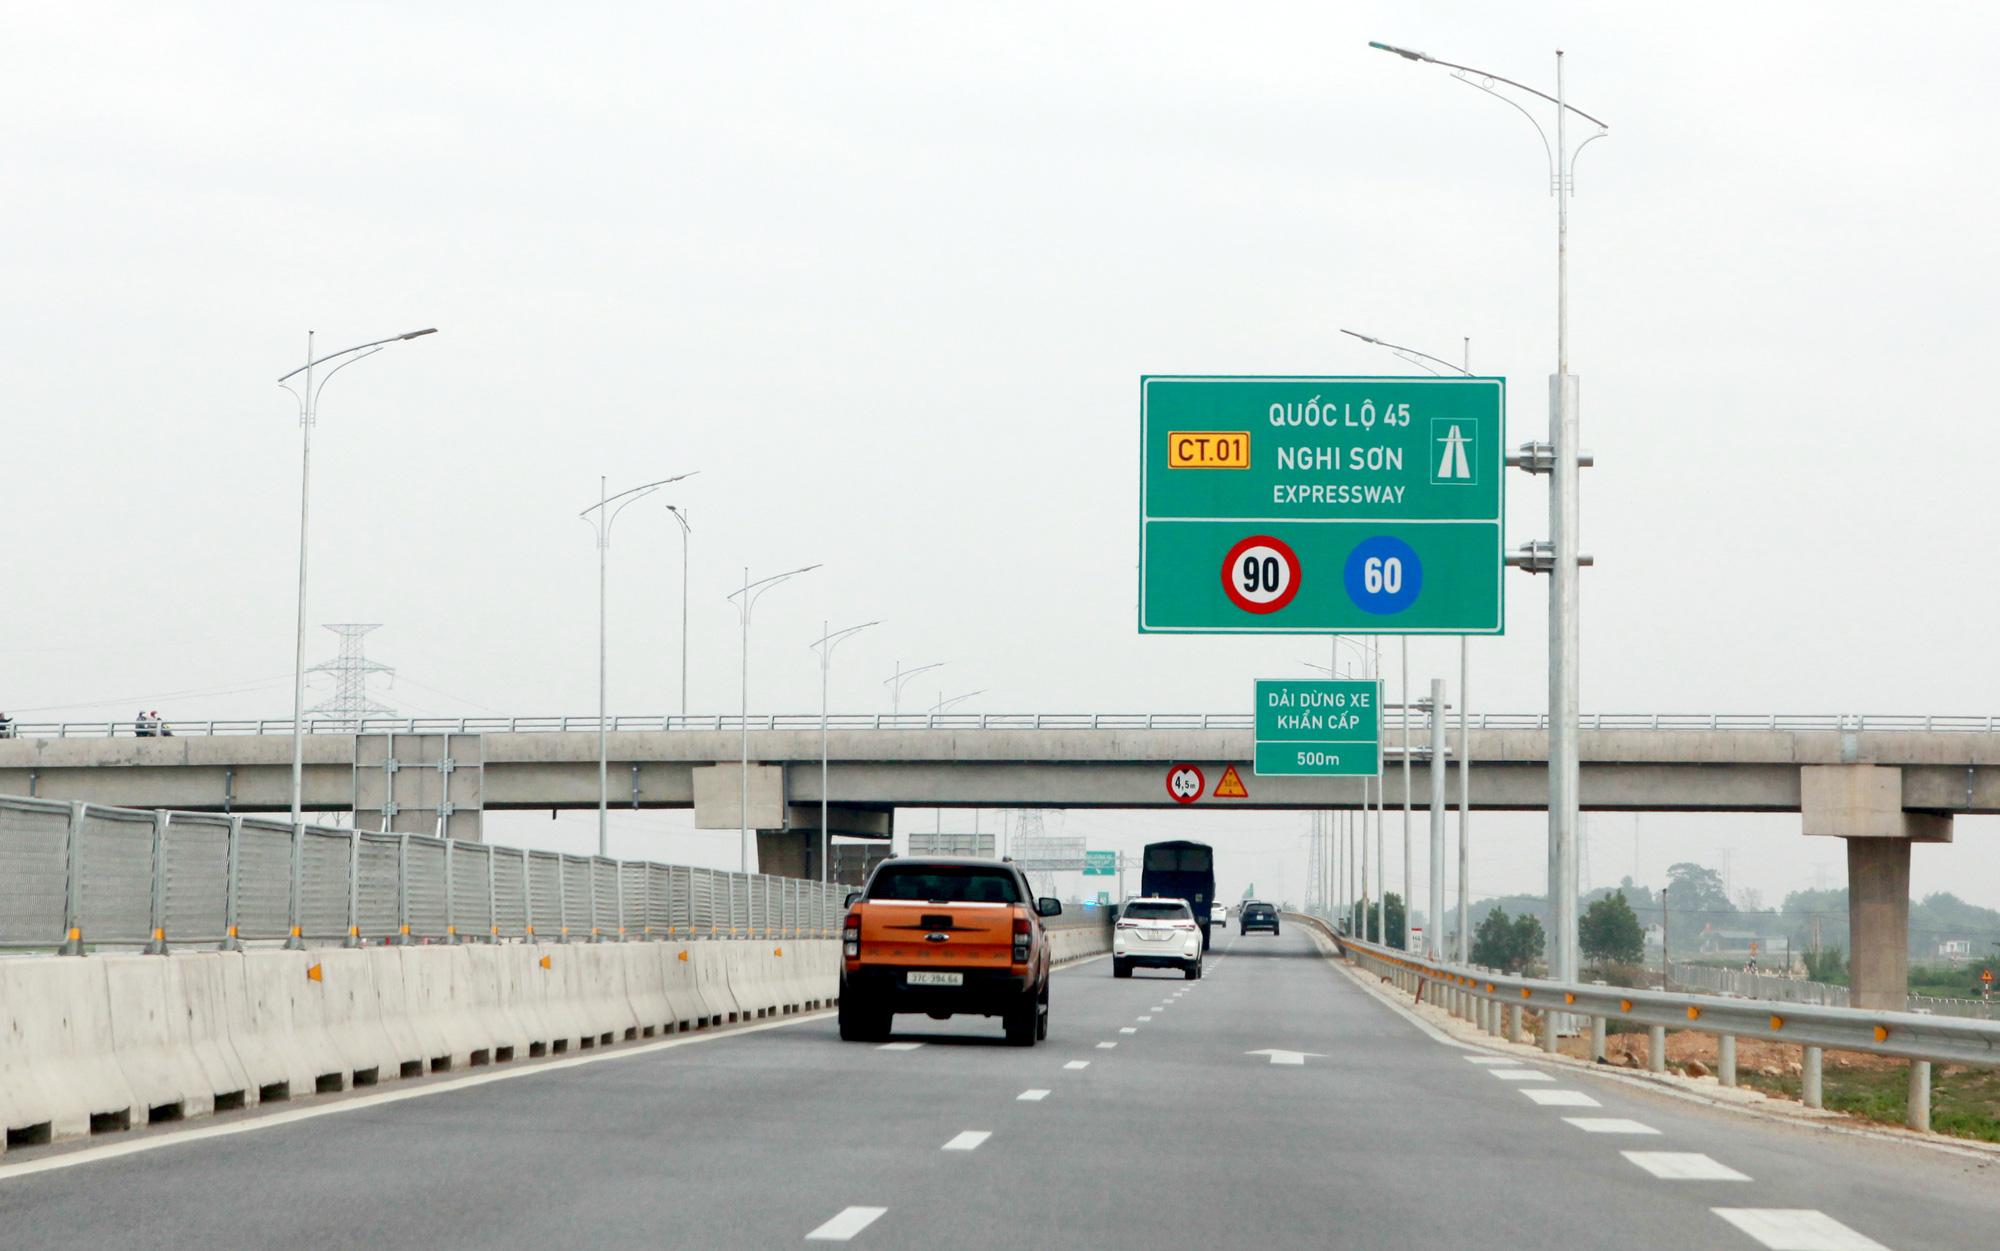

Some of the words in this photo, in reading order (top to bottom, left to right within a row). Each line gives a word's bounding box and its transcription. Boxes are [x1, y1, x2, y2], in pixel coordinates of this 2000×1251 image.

[1269, 395, 1337, 427] QUỐC
[1345, 399, 1376, 431] LỘ
[1384, 403, 1411, 427] 45
[1178, 439, 1241, 462] CT.01
[1277, 446, 1341, 470] NGHI
[1349, 446, 1403, 470] SƠN
[1273, 485, 1406, 503] EXPRESSWAY
[1243, 556, 1280, 593] 90
[1364, 557, 1402, 594] 60
[1269, 688, 1295, 708] DẢI
[1300, 690, 1346, 708] DỪNG
[1350, 693, 1371, 708] XE
[1277, 709, 1323, 730] KHẨN
[1328, 710, 1360, 730] CẤP
[1297, 752, 1340, 766] 500m
